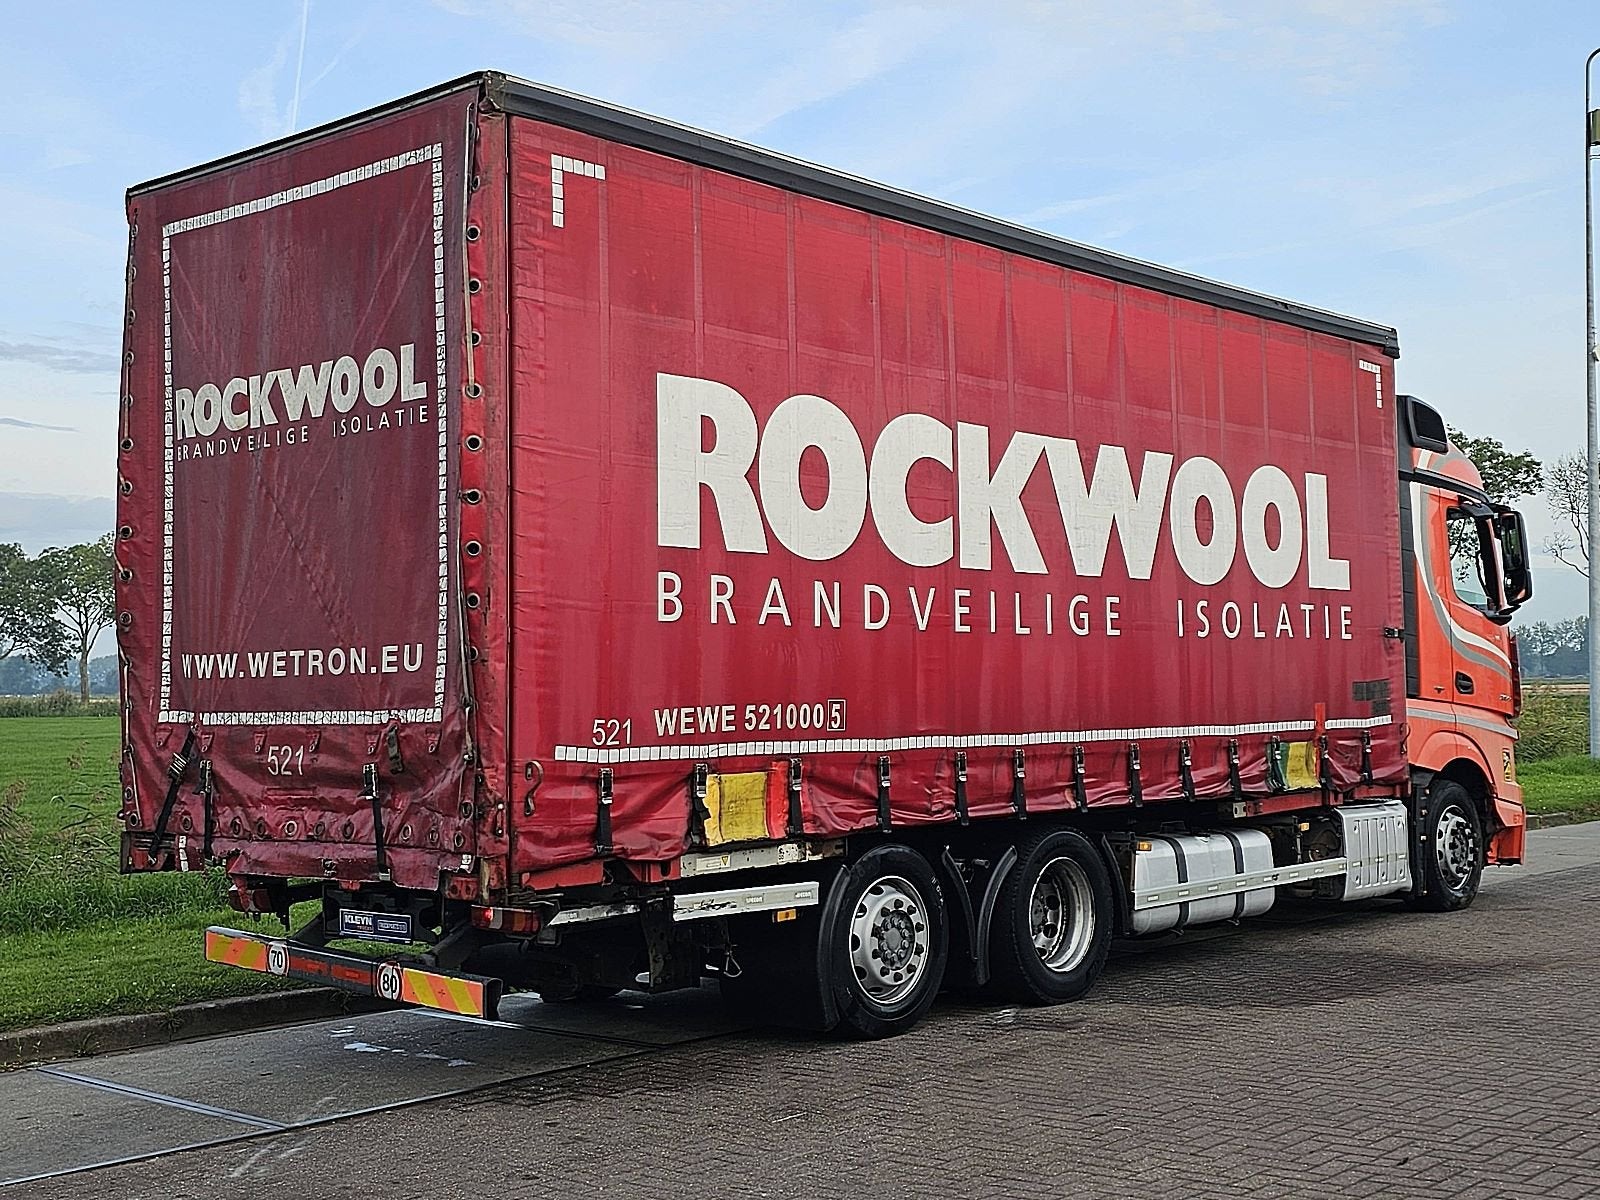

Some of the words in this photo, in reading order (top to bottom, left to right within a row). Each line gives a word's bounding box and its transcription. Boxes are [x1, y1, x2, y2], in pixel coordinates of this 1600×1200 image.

[175, 343, 428, 441] ROCKWOOL
[176, 425, 310, 462] BRANDVEILIGE
[332, 405, 429, 438] ISOLATIE
[656, 371, 1351, 591] ROCKWOOL
[656, 570, 1122, 637] BRANDVEILIGE
[1176, 598, 1353, 640] ISOLATIE
[181, 643, 425, 679] WWW.WETRON.EU
[592, 718, 633, 747] 521
[653, 704, 736, 738] WEWE
[266, 744, 306, 777] 521
[344, 914, 373, 926] KLEYN
[270, 949, 283, 969] 70
[382, 973, 398, 994] 80
